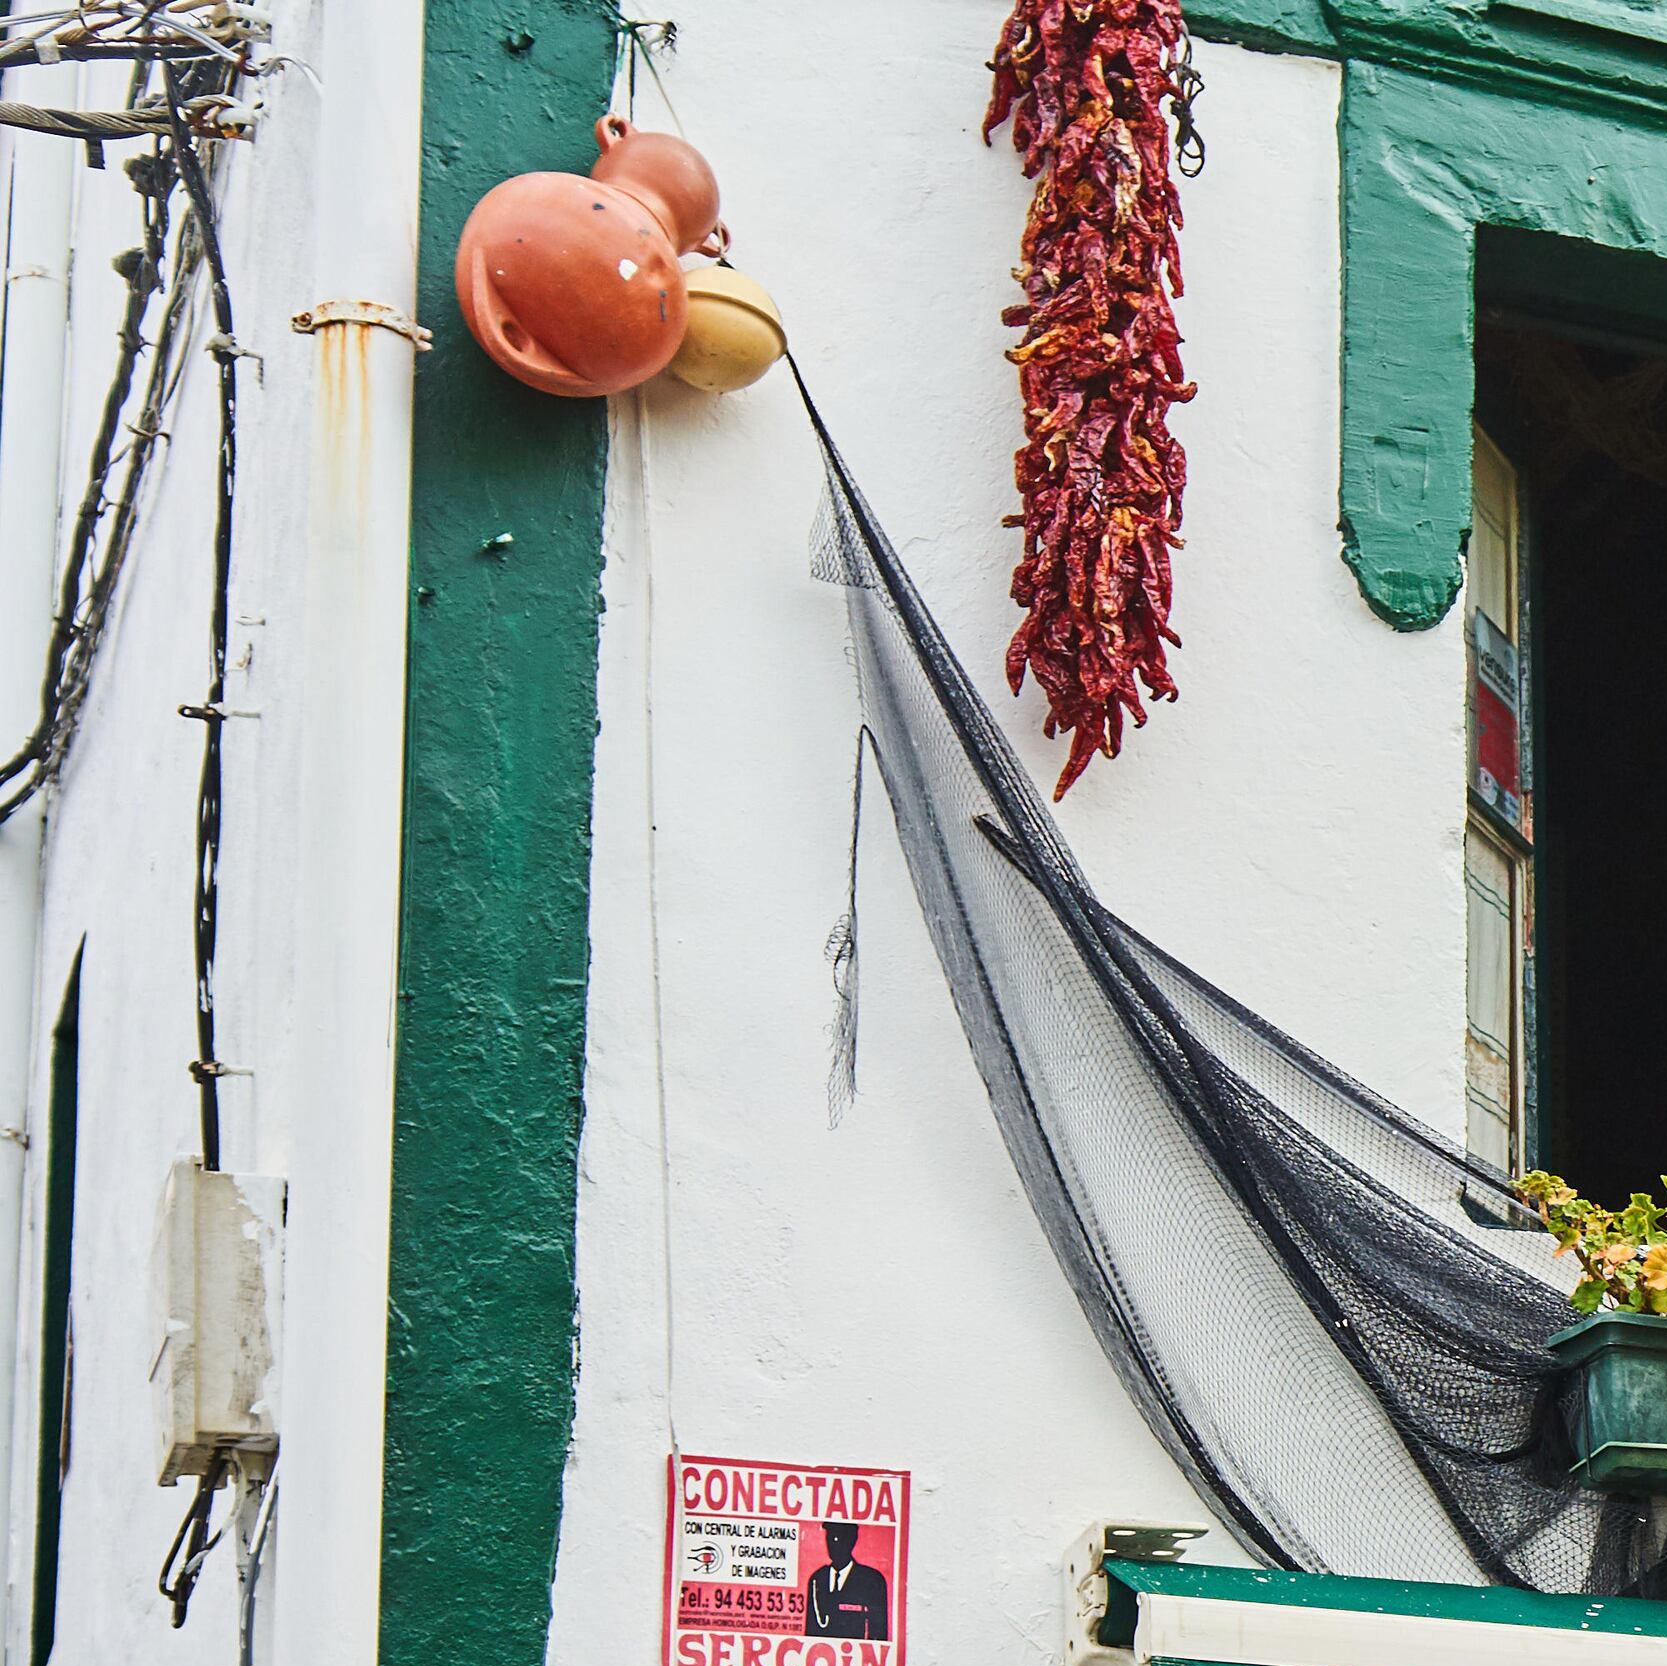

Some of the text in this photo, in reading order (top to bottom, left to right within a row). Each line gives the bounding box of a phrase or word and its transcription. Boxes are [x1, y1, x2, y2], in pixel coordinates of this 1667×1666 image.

[683, 1467, 896, 1522] CONECTADA
[685, 1522, 797, 1540] CON CENTRAL DE ALARMAS
[731, 1545, 786, 1560] Y GRABACION
[732, 1565, 786, 1580] DE IMAGENES
[715, 1589, 732, 1609] 94
[737, 1590, 762, 1611] 453
[767, 1592, 783, 1612] 53
[788, 1593, 804, 1613] 53
